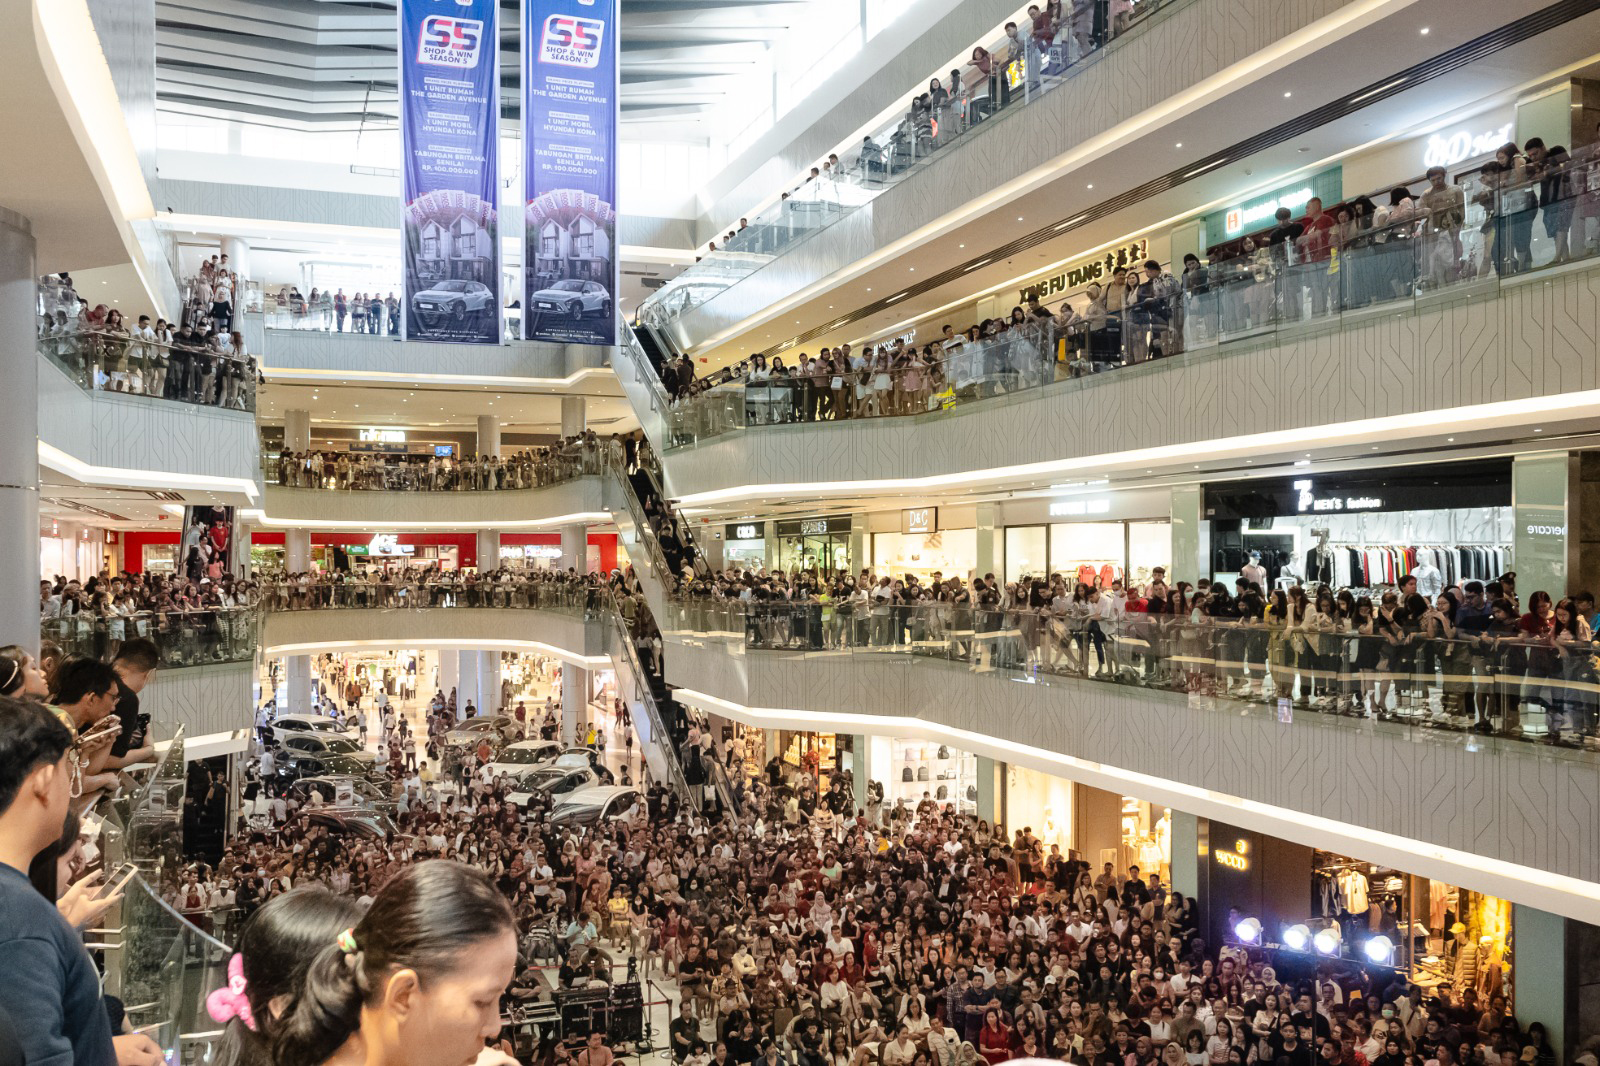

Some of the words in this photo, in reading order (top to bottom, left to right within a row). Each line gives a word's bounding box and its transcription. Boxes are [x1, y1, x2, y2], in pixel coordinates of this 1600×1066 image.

[546, 46, 567, 54] SHOP
[430, 54, 460, 63] SEASON
[551, 54, 581, 63] SEASON
[569, 87, 594, 95] RUMAH
[427, 92, 456, 100] GARDEN
[549, 92, 576, 100] GARDEN
[544, 124, 574, 133] HYUNDAI
[414, 151, 452, 159] TABUNGAN
[535, 149, 572, 158] TABUNGAN
[575, 154, 604, 162] BRITAMA
[1050, 274, 1065, 294] FU
[1067, 262, 1102, 287] TANG
[1314, 498, 1342, 510] MEN'S
[1347, 497, 1382, 509] fashion
[910, 510, 928, 526] D&C
